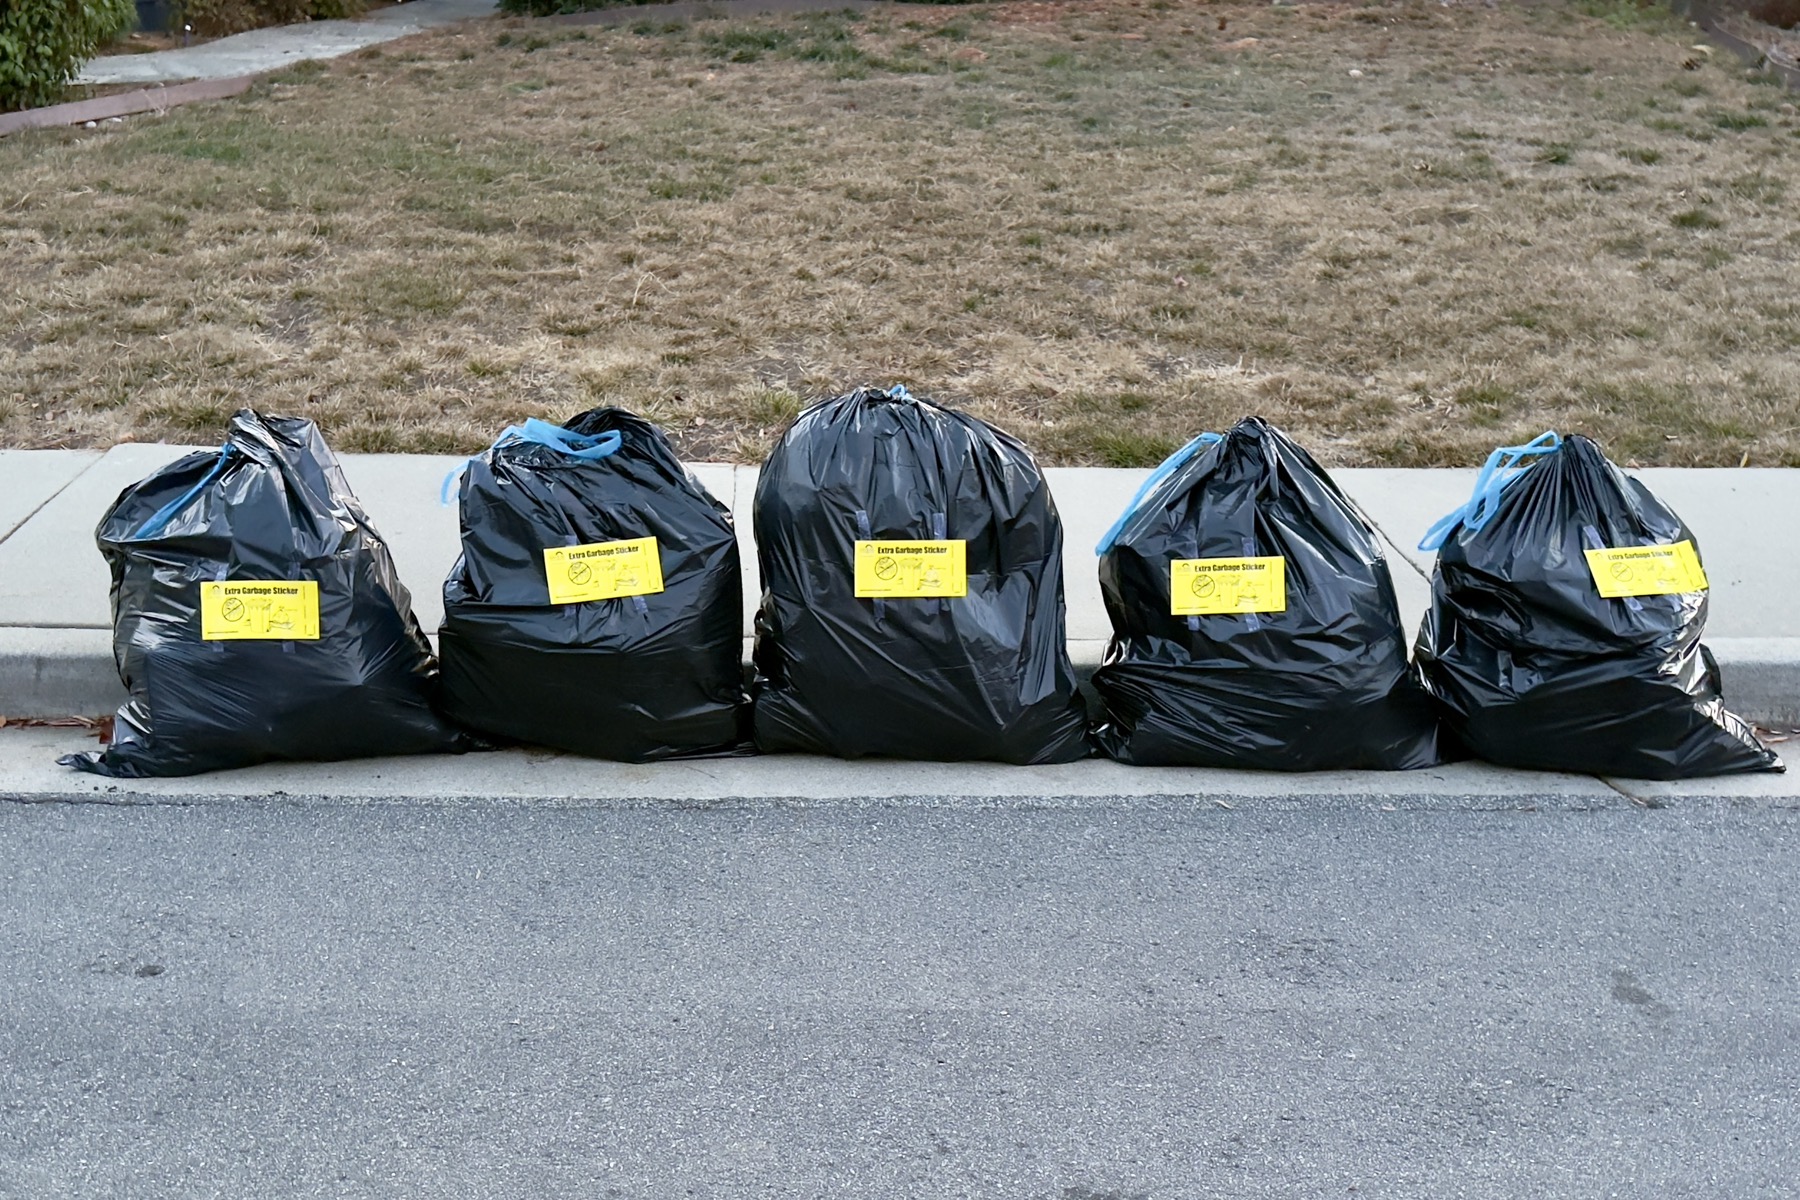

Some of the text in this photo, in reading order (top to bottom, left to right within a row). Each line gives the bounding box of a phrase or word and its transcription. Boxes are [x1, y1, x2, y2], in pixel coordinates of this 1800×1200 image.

[568, 551, 586, 560] Extra
[586, 549, 615, 558] Garbage
[615, 546, 639, 555] Sticker
[877, 546, 894, 554] Extra
[895, 546, 923, 555] Garbage
[924, 546, 947, 554] Sticker
[1194, 565, 1212, 573] Extra
[1212, 564, 1240, 572] Garbage
[1241, 563, 1265, 571] Sticker
[224, 587, 241, 595] Extra
[242, 587, 272, 596] Garbage
[273, 587, 299, 595] Sticker
